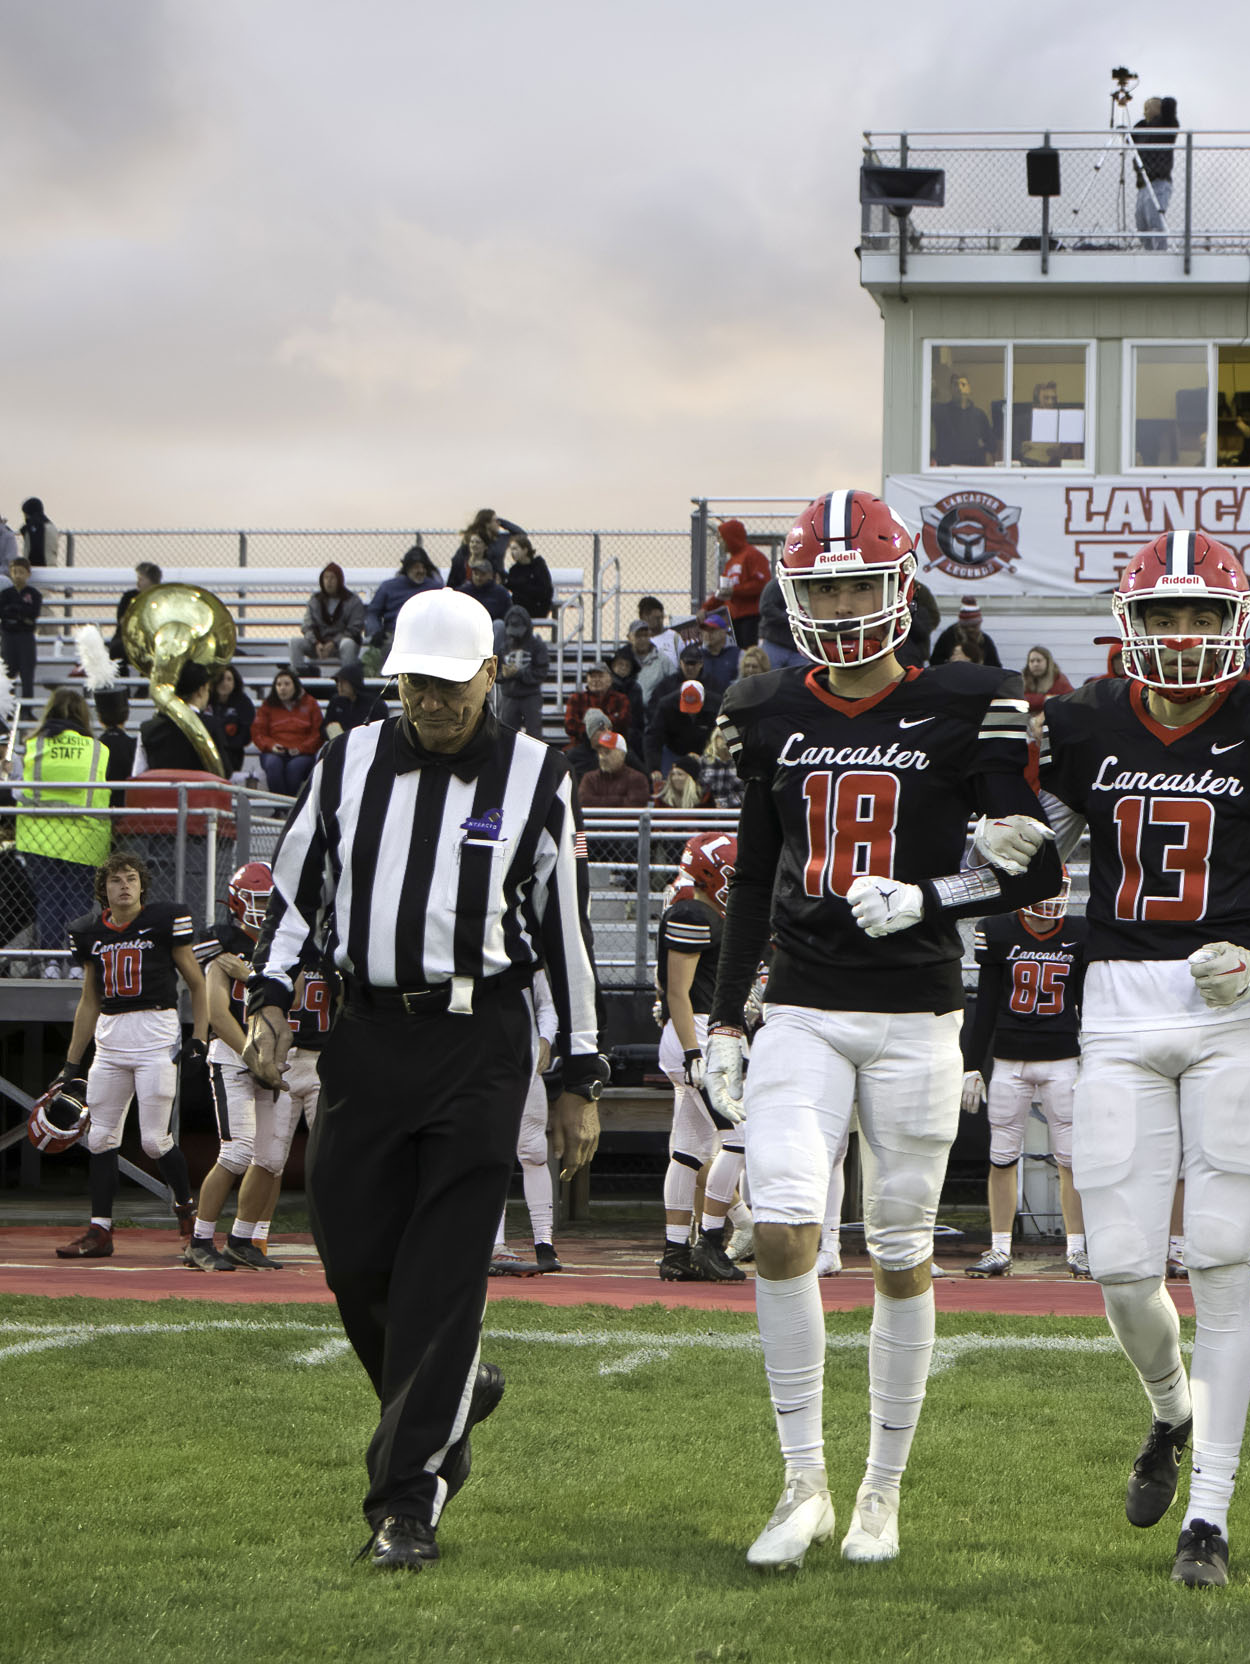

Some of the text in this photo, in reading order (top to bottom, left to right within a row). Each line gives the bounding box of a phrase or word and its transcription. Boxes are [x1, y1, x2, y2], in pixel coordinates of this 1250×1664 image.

[942, 494, 1001, 511] LANCASTER
[819, 552, 857, 564] Riddell
[1161, 576, 1200, 585] Riddell
[50, 746, 86, 760] STAFF
[777, 732, 930, 771] Lancaster
[1091, 755, 1245, 797] Lancaster
[801, 770, 901, 899] 18
[1113, 795, 1216, 922] 13
[91, 937, 155, 956] Lancaster
[1006, 945, 1075, 963] Lancaster
[101, 948, 143, 999] 10
[1009, 960, 1071, 1015] 85
